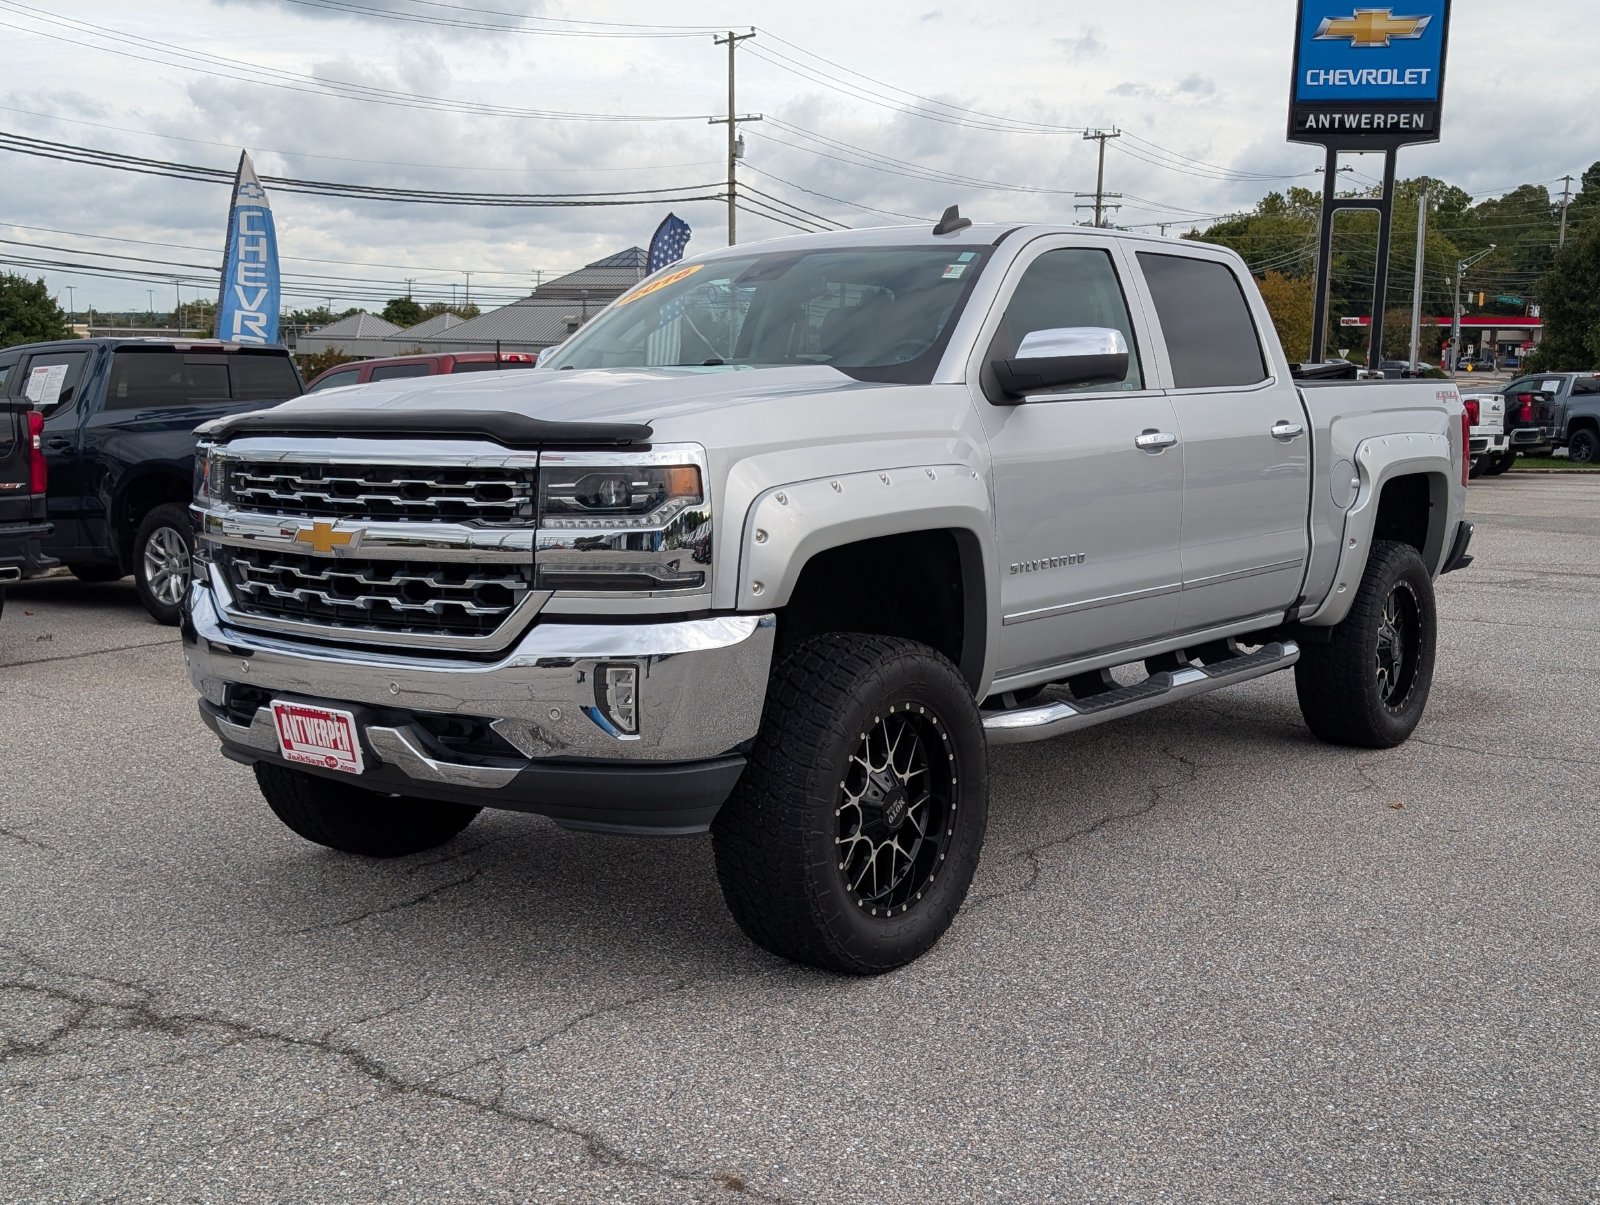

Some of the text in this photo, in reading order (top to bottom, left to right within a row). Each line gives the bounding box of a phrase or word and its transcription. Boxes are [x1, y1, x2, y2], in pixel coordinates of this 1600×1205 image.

[1306, 68, 1432, 86] CHEVROLET
[1305, 113, 1425, 129] ANTWERPEN
[1010, 552, 1086, 575] SILVERADO
[281, 713, 351, 750] ANTWERPEN
